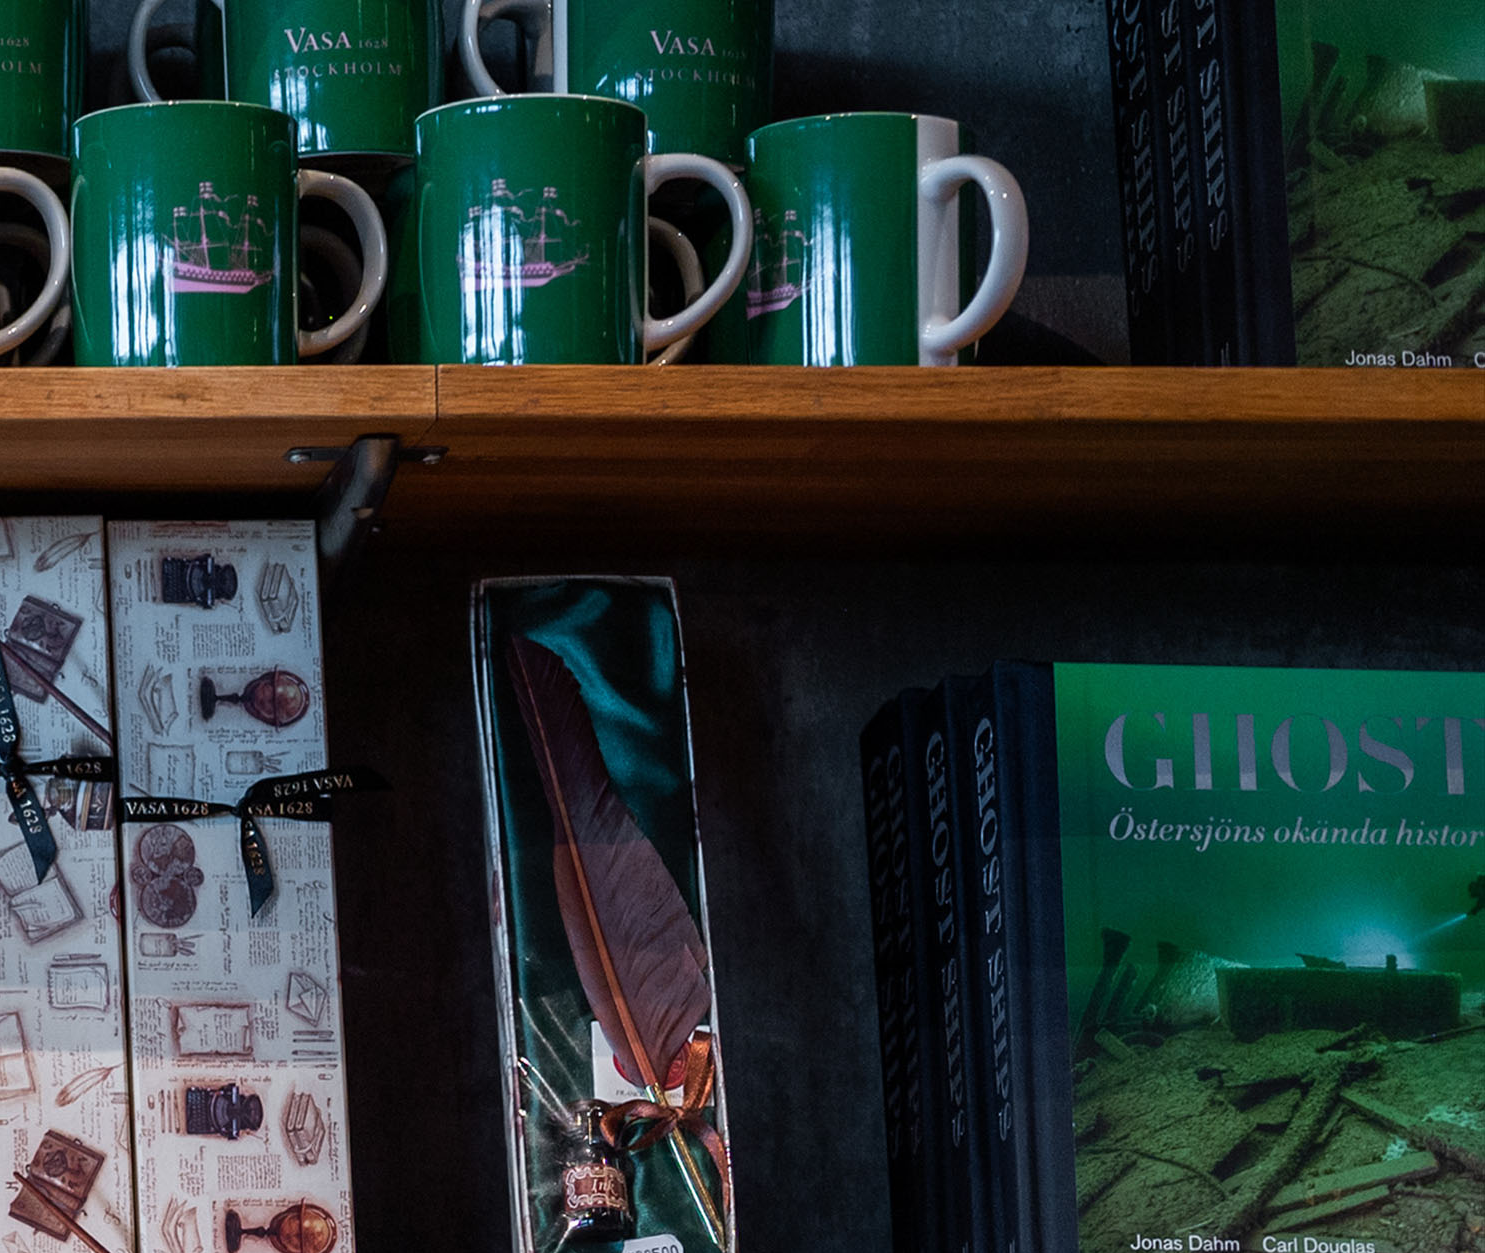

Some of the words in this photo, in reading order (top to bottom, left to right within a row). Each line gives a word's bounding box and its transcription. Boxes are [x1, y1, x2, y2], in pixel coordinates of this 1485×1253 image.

[0, 37, 30, 47] 1628
[284, 27, 352, 53] VASA
[649, 30, 717, 56] VASA
[1199, 59, 1229, 250] SHIPS
[1167, 86, 1195, 273] SHIPS
[1345, 349, 1396, 366] Jonas
[1402, 350, 1452, 367] Dahm
[1105, 712, 1485, 795] GHOST
[273, 780, 309, 798] 1628
[313, 773, 354, 791] VASA
[125, 801, 169, 816] VASA
[173, 801, 210, 816] 1628
[279, 801, 313, 816] 1628
[973, 717, 1002, 934] GHOST
[1109, 807, 1265, 852] Östersjöns
[1273, 816, 1387, 846] okända
[925, 731, 955, 944] GHOST
[941, 958, 966, 1147] SHIPS
[987, 948, 1012, 1140] SHIPS
[592, 1178, 617, 1195] Ink
[1130, 1234, 1183, 1251] Jonas
[1189, 1235, 1240, 1252] Dahm
[1262, 1236, 1298, 1253] Carl
